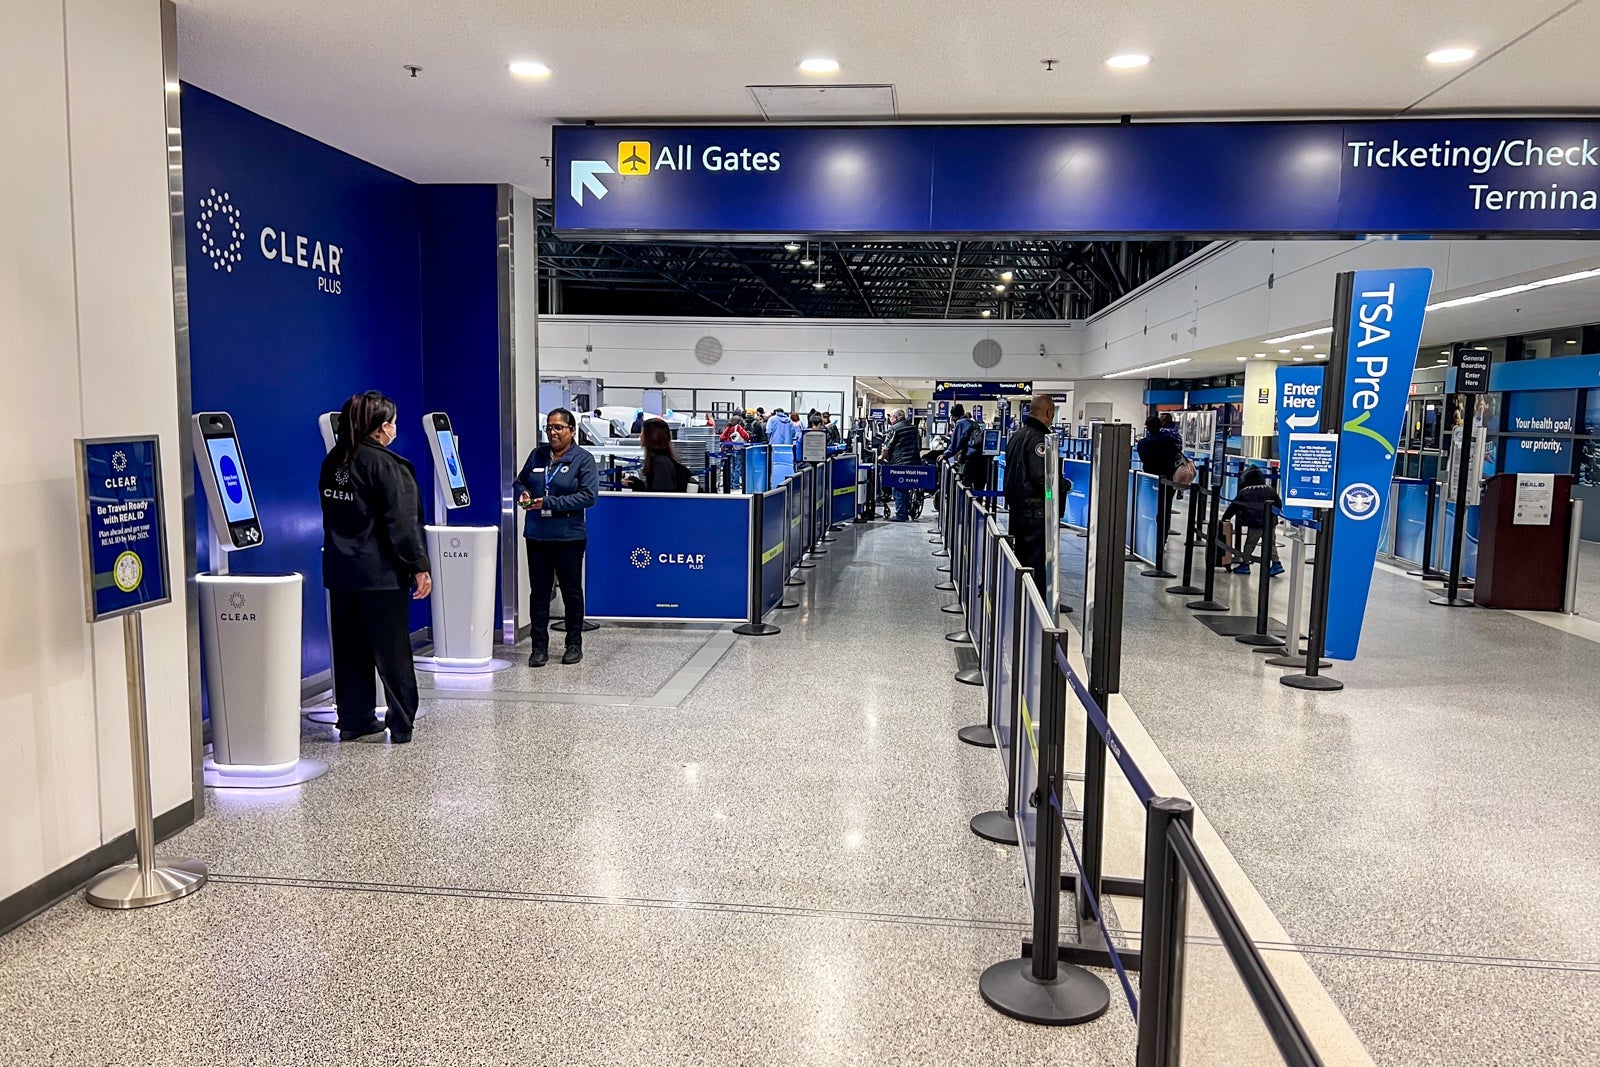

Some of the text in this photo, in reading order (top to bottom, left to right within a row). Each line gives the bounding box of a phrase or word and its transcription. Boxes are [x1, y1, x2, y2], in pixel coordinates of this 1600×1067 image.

[655, 144, 781, 171] All Gates
[1348, 139, 1598, 173] Ticketing/Check
[260, 226, 341, 276] CLEAR
[318, 276, 341, 295] PLUS
[1352, 282, 1395, 410] TSA Pre
[1462, 354, 1485, 362] General
[1460, 362, 1487, 371] Boarding
[1283, 382, 1322, 396] Enter
[1282, 395, 1316, 409] Here
[1515, 417, 1573, 433] Your health goal,
[1520, 439, 1563, 454] our priority.
[105, 476, 137, 488] CLEAR
[97, 500, 148, 515] Be Travel Ready
[103, 511, 145, 525] with REAL ID
[98, 530, 110, 538] Plan
[658, 553, 704, 564] CLEAR
[220, 612, 256, 622] CLEAR
